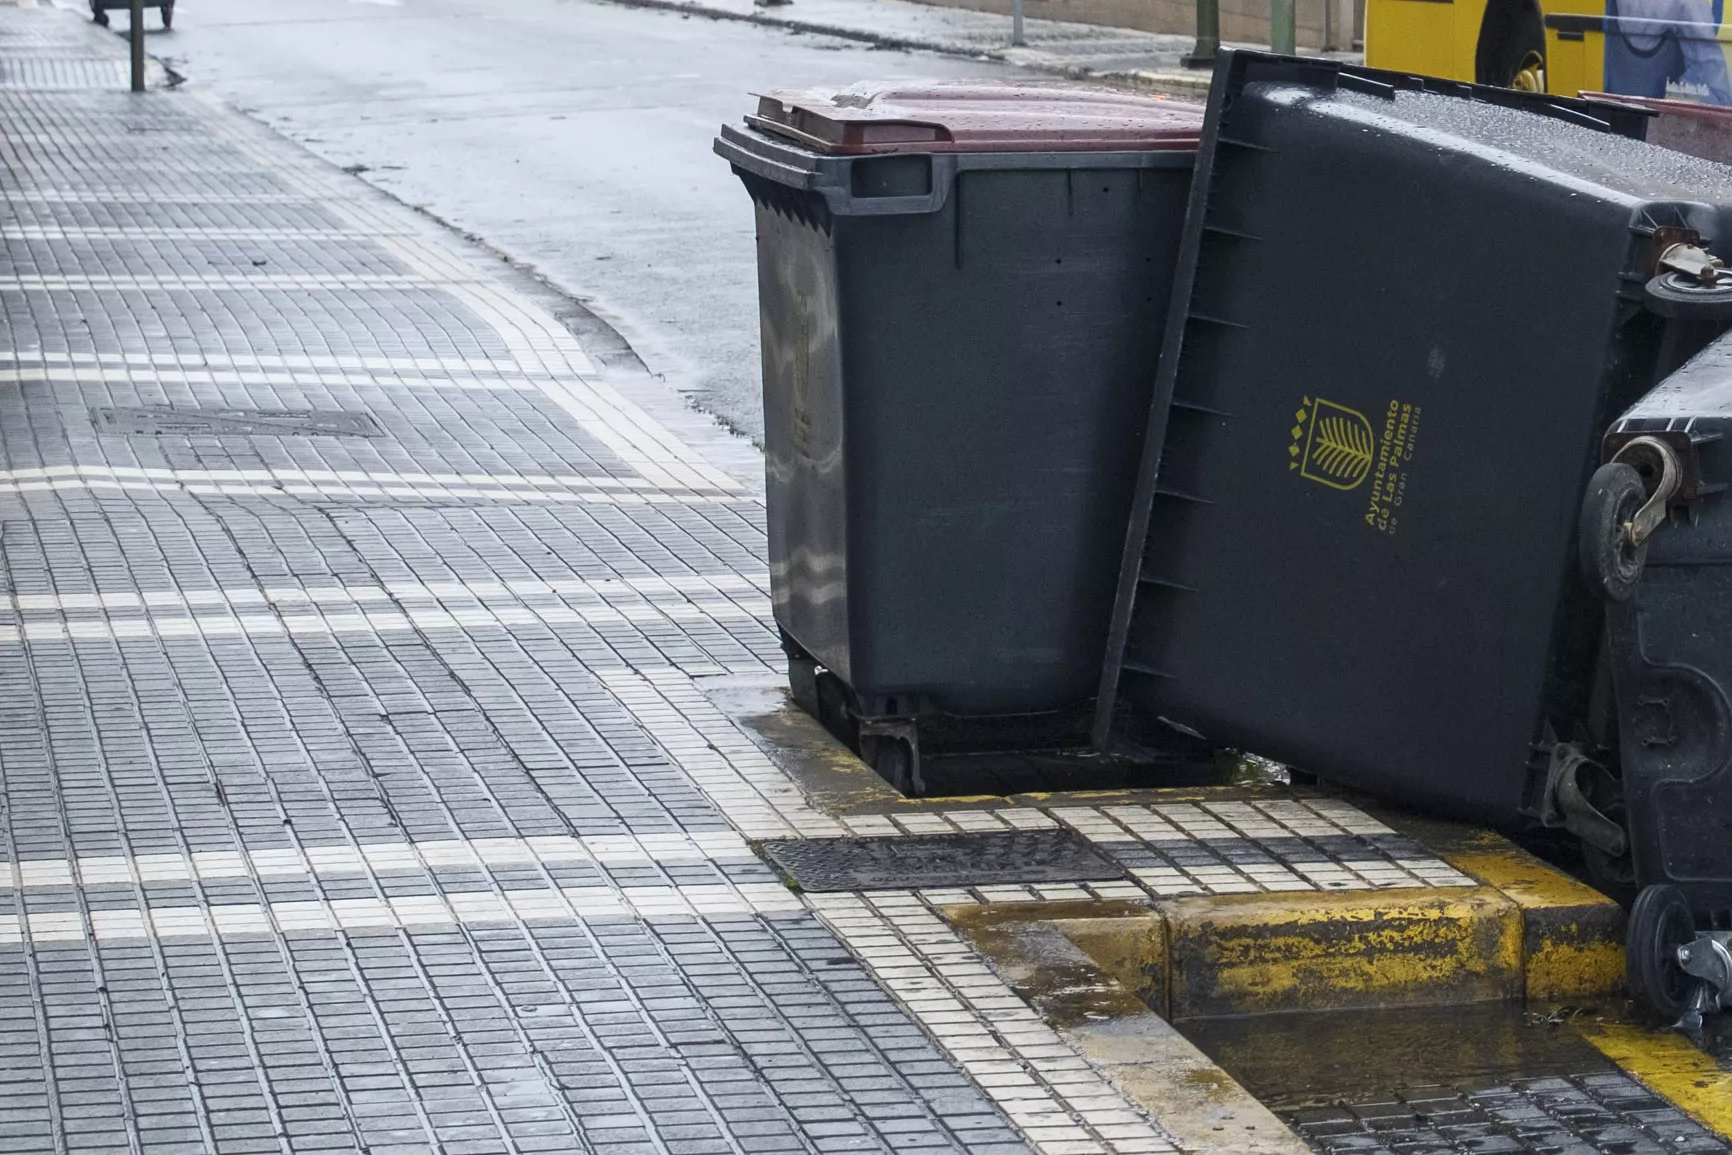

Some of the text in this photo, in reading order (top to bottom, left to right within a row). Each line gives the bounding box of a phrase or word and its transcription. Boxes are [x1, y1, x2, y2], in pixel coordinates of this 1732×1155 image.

[1364, 399, 1399, 526] Ayuntamiento
[1378, 403, 1412, 531] de Las Palmas
[1388, 406, 1422, 535] de Gran Canaria
